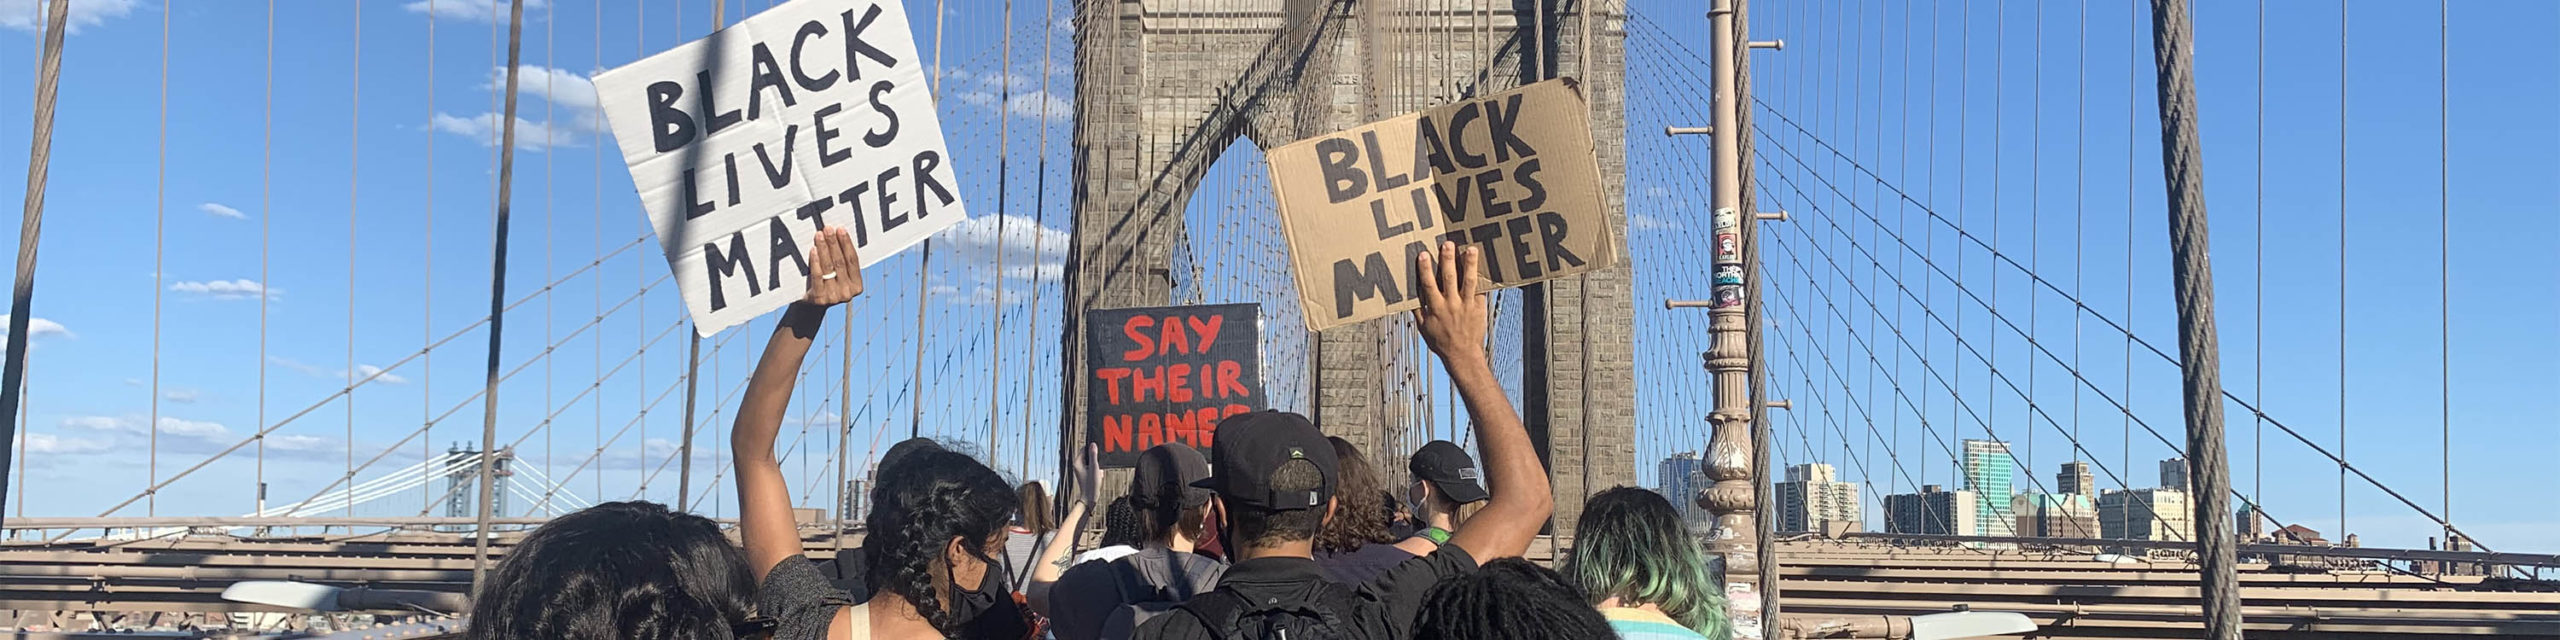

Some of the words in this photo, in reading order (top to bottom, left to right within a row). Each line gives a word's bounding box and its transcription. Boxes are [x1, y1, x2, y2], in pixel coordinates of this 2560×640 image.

[646, 2, 898, 154] BLACK
[683, 80, 900, 221] LIVES
[1315, 94, 1537, 204] BLACK
[1370, 158, 1547, 241] LIVES
[704, 150, 955, 314] MATTER
[1095, 360, 1250, 406] THEIR
[1123, 314, 1224, 362] SAY
